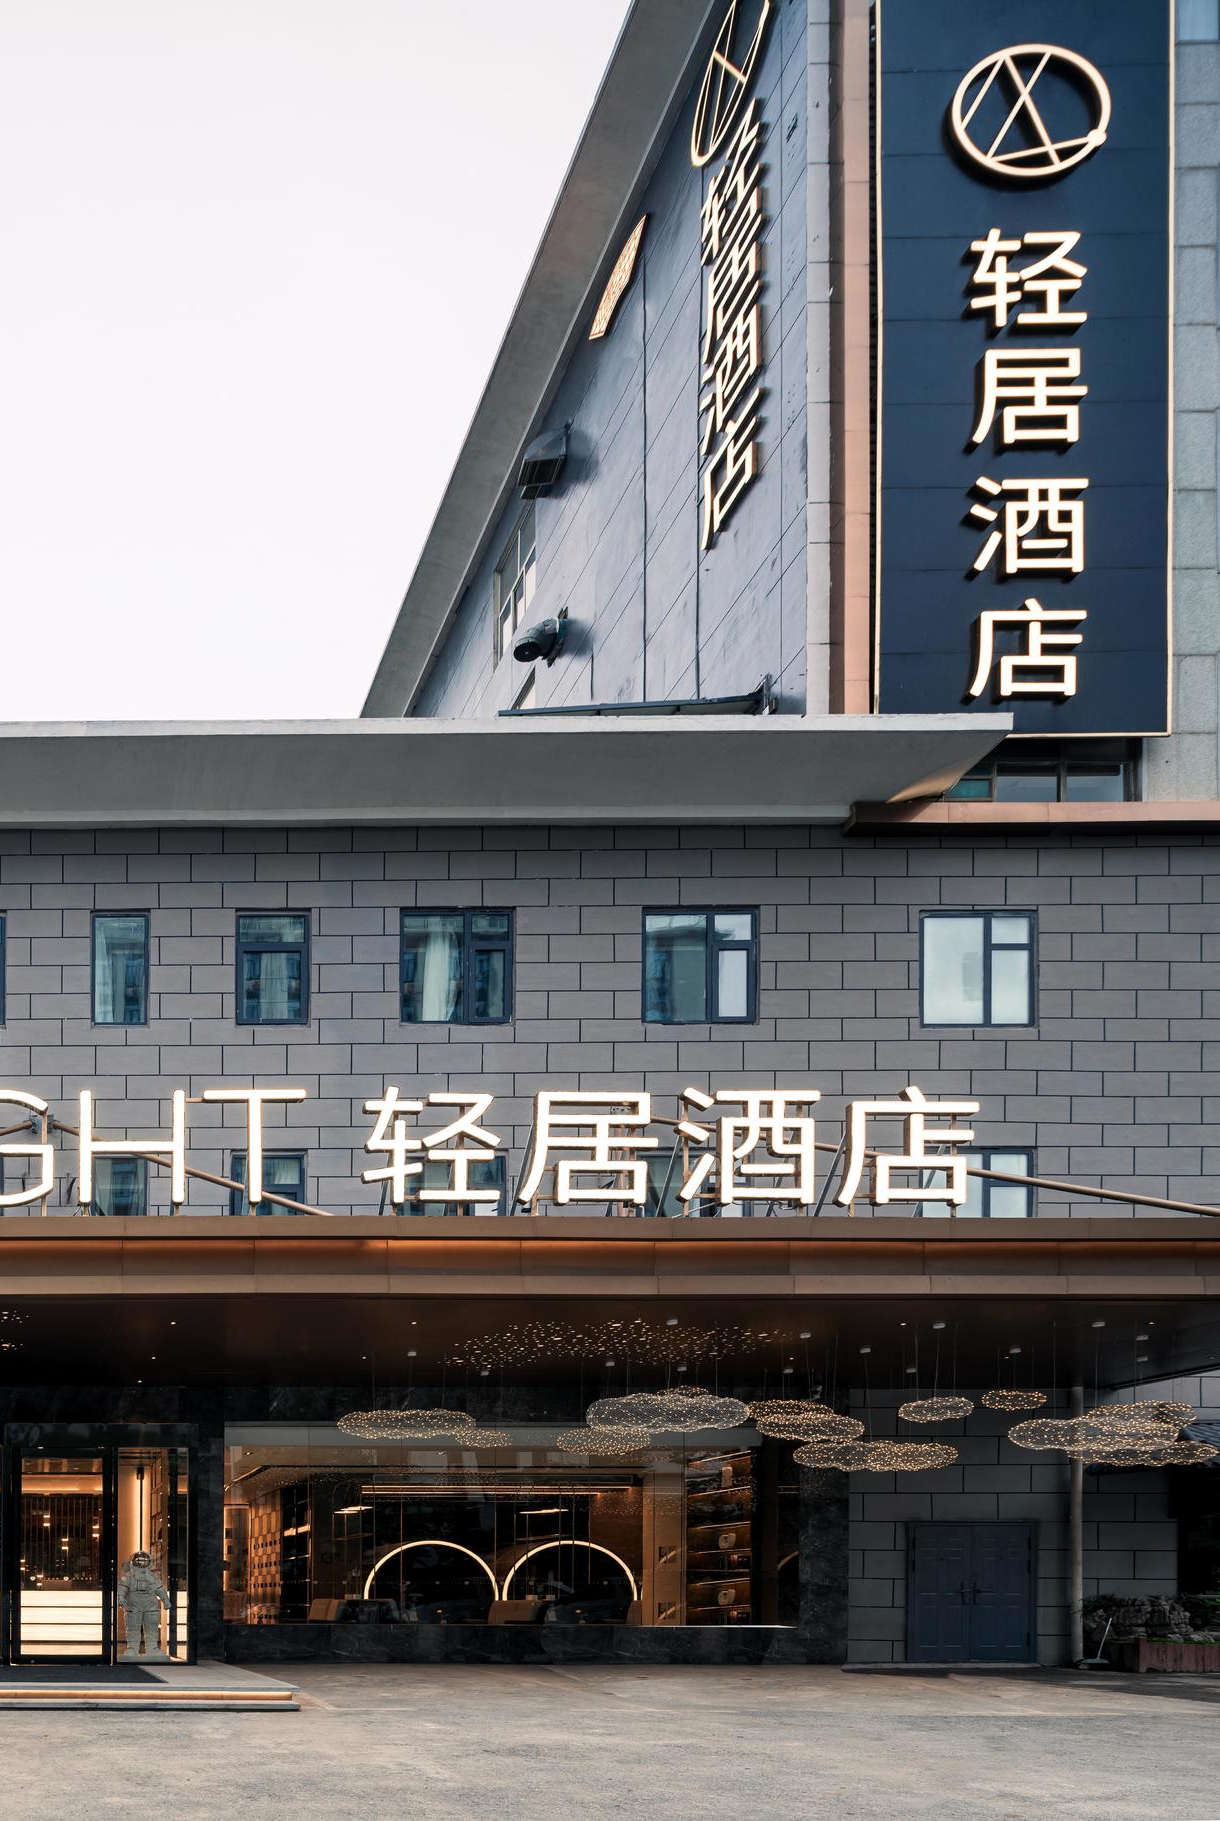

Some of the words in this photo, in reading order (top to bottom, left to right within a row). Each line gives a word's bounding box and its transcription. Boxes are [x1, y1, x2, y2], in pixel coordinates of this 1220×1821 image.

[700, 97, 762, 550] 轻居酒店
[969, 229, 1089, 698] 轻居酒店
[362, 1086, 981, 1207] 轻居酒店
